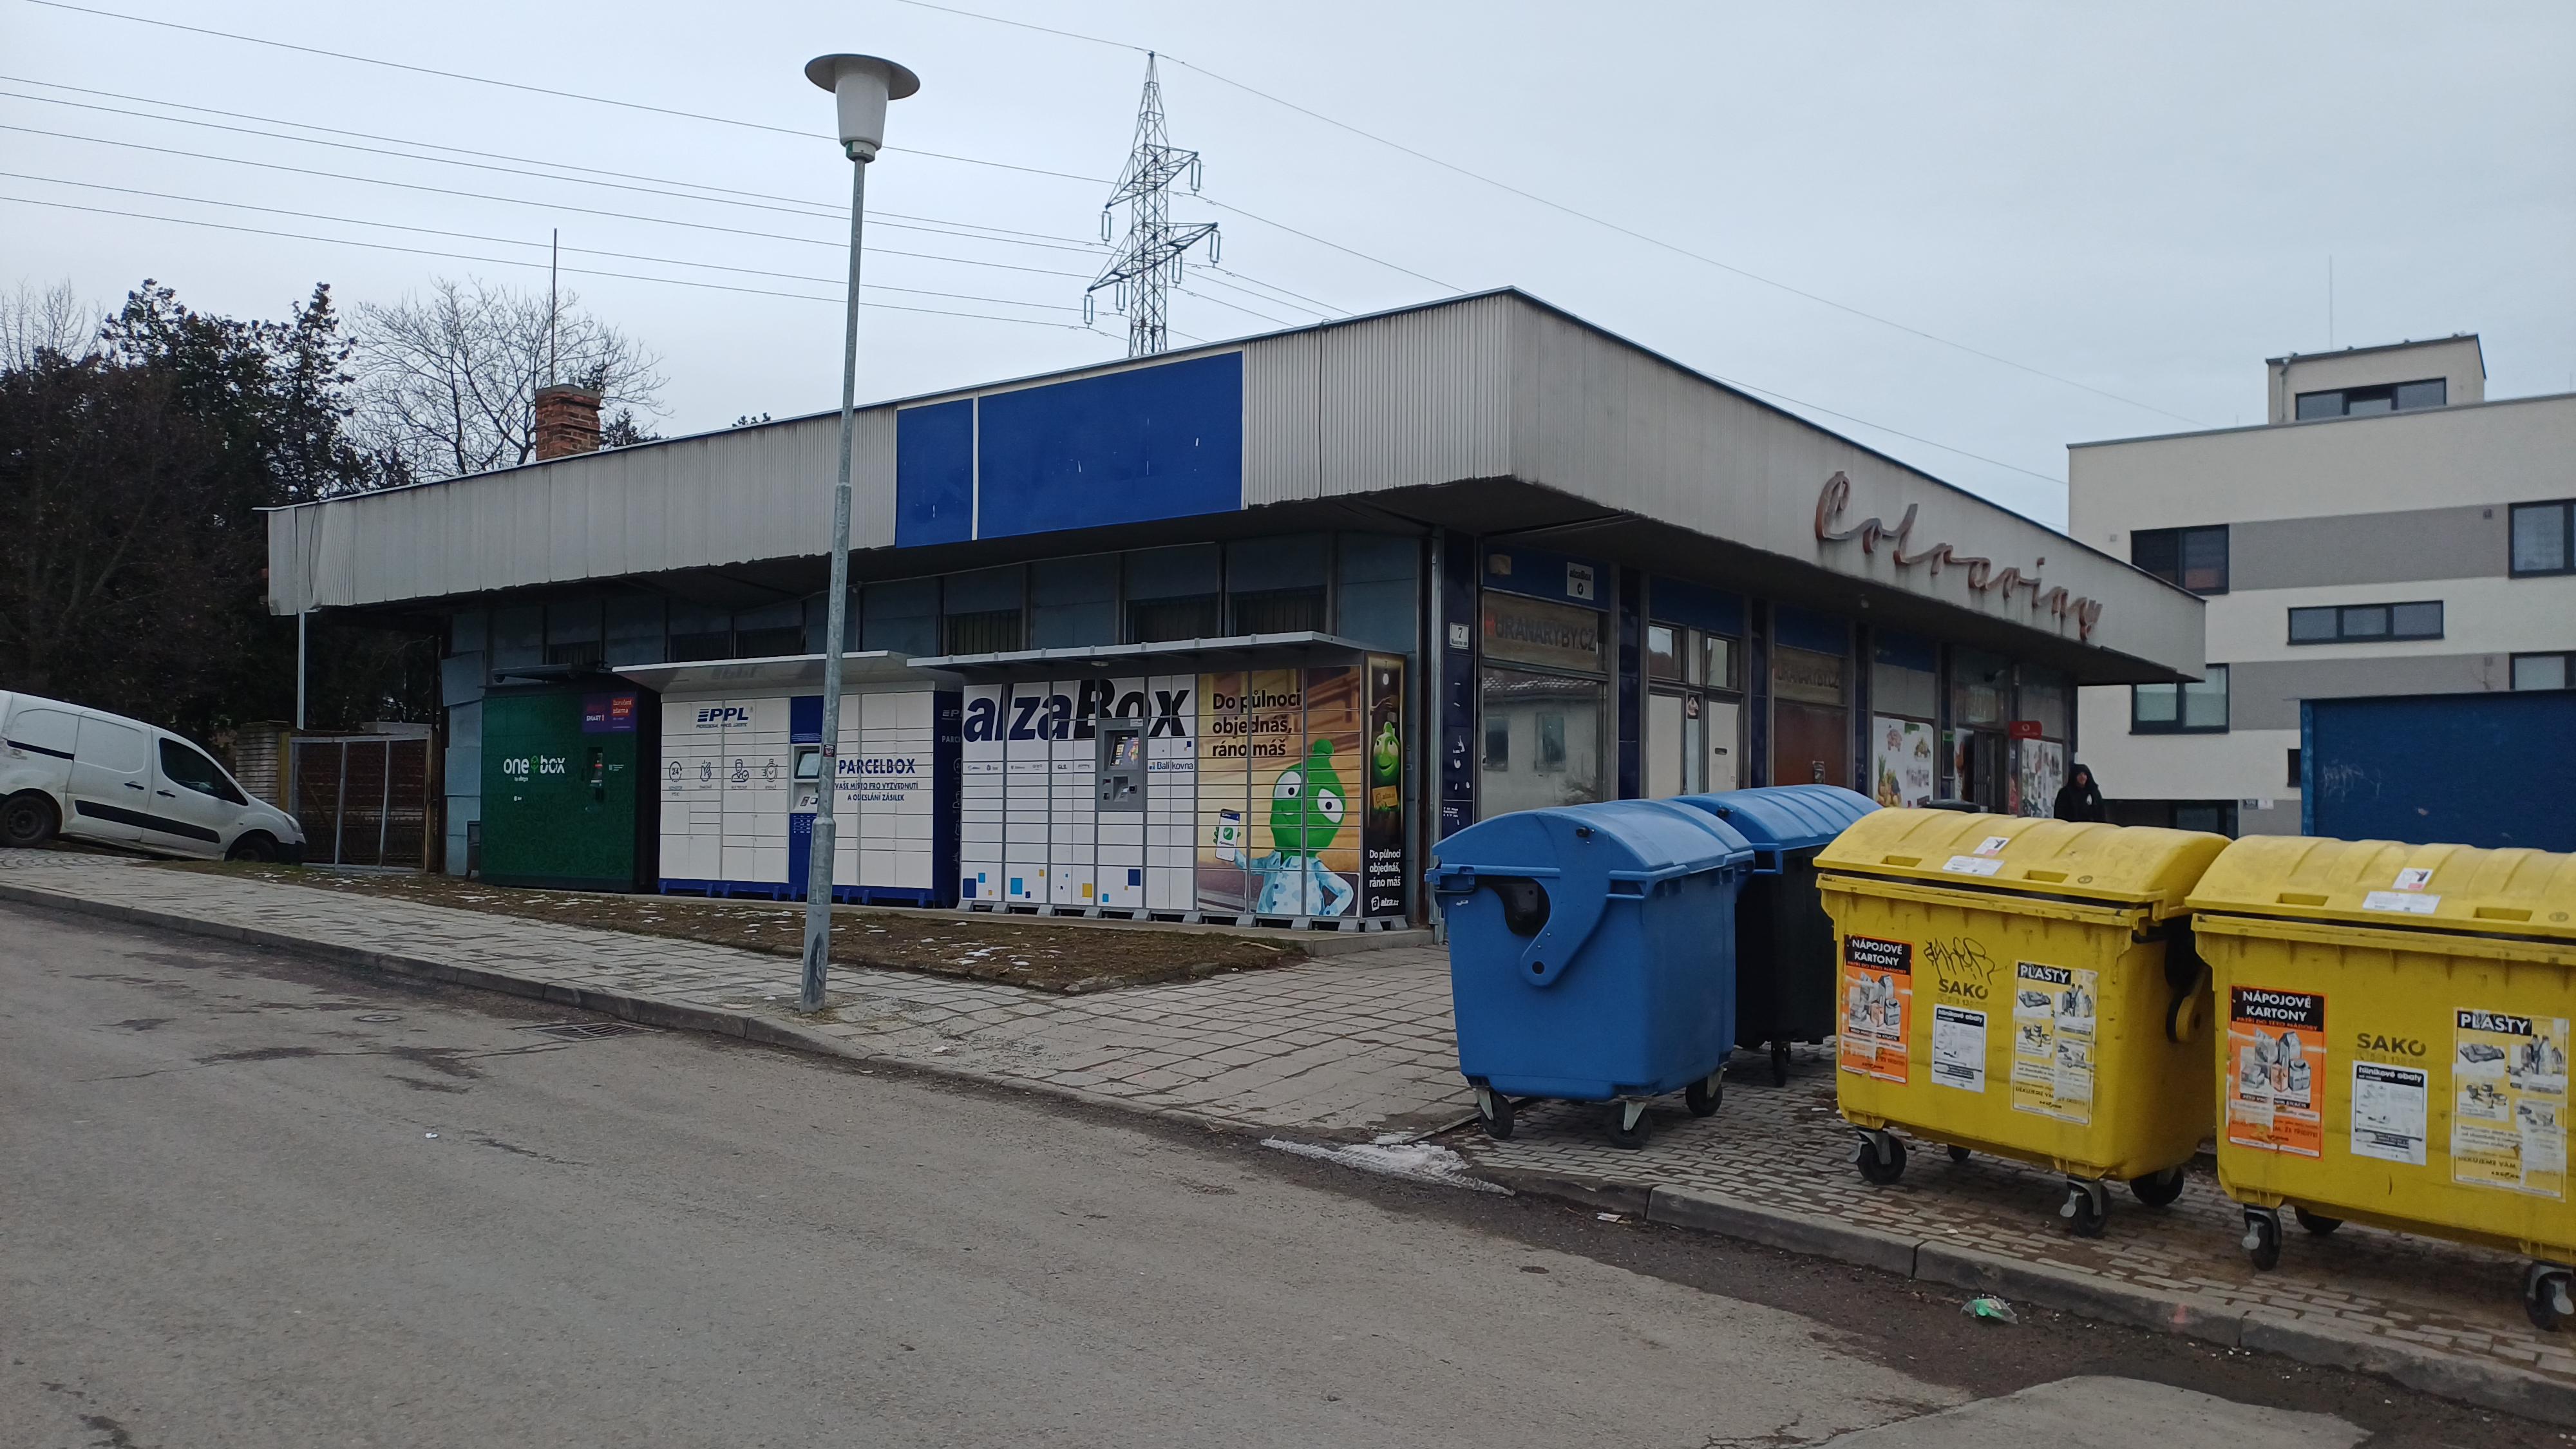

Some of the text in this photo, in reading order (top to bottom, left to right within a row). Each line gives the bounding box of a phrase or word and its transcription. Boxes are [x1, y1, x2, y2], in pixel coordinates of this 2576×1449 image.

[1458, 627, 1463, 638] 7
[1213, 688, 1301, 713] Do půlnoci
[709, 707, 749, 722] PPL
[963, 679, 1191, 743] alzaBox
[1212, 715, 1293, 739] objednáš,
[1212, 738, 1286, 757] ráno máš
[504, 755, 565, 774] one box
[838, 758, 916, 775] PARCELBOX
[1369, 848, 1401, 861] Do půlnoci
[1369, 862, 1401, 875] objednáš,
[1369, 876, 1401, 887] ráno máš
[1852, 938, 1903, 955] NÁPOJOVÉ
[1854, 951, 1900, 966] KARTONY
[2020, 964, 2070, 985] PLASTY
[1938, 978, 1989, 1000] SAKO
[2242, 990, 2311, 1009] NÁPOJOVÉ
[2246, 1005, 2307, 1023] KARTONY
[2460, 1013, 2528, 1034] PLASTY
[2357, 1032, 2427, 1057] SAKO
